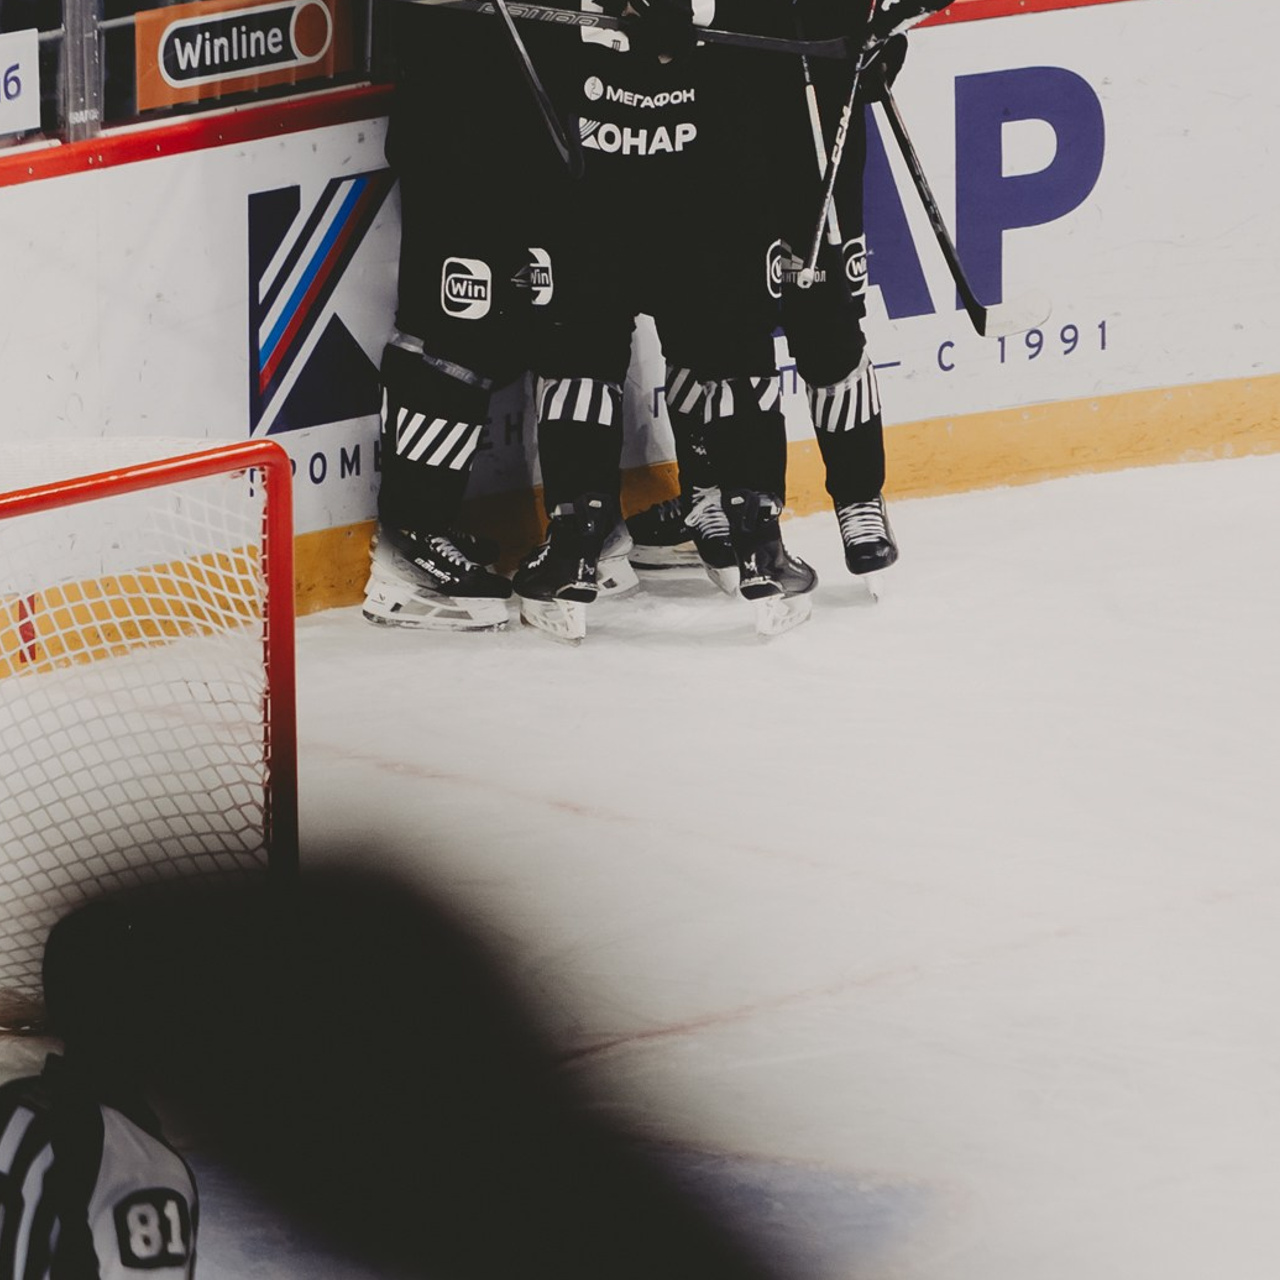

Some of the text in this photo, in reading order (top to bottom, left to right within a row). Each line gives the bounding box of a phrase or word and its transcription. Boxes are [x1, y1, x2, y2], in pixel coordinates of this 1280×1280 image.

[173, 25, 284, 71] Winline
[606, 85, 695, 108] МЕГАФОН
[451, 277, 486, 299] Win
[997, 320, 1107, 364] 1991
[126, 1199, 185, 1259] 81
